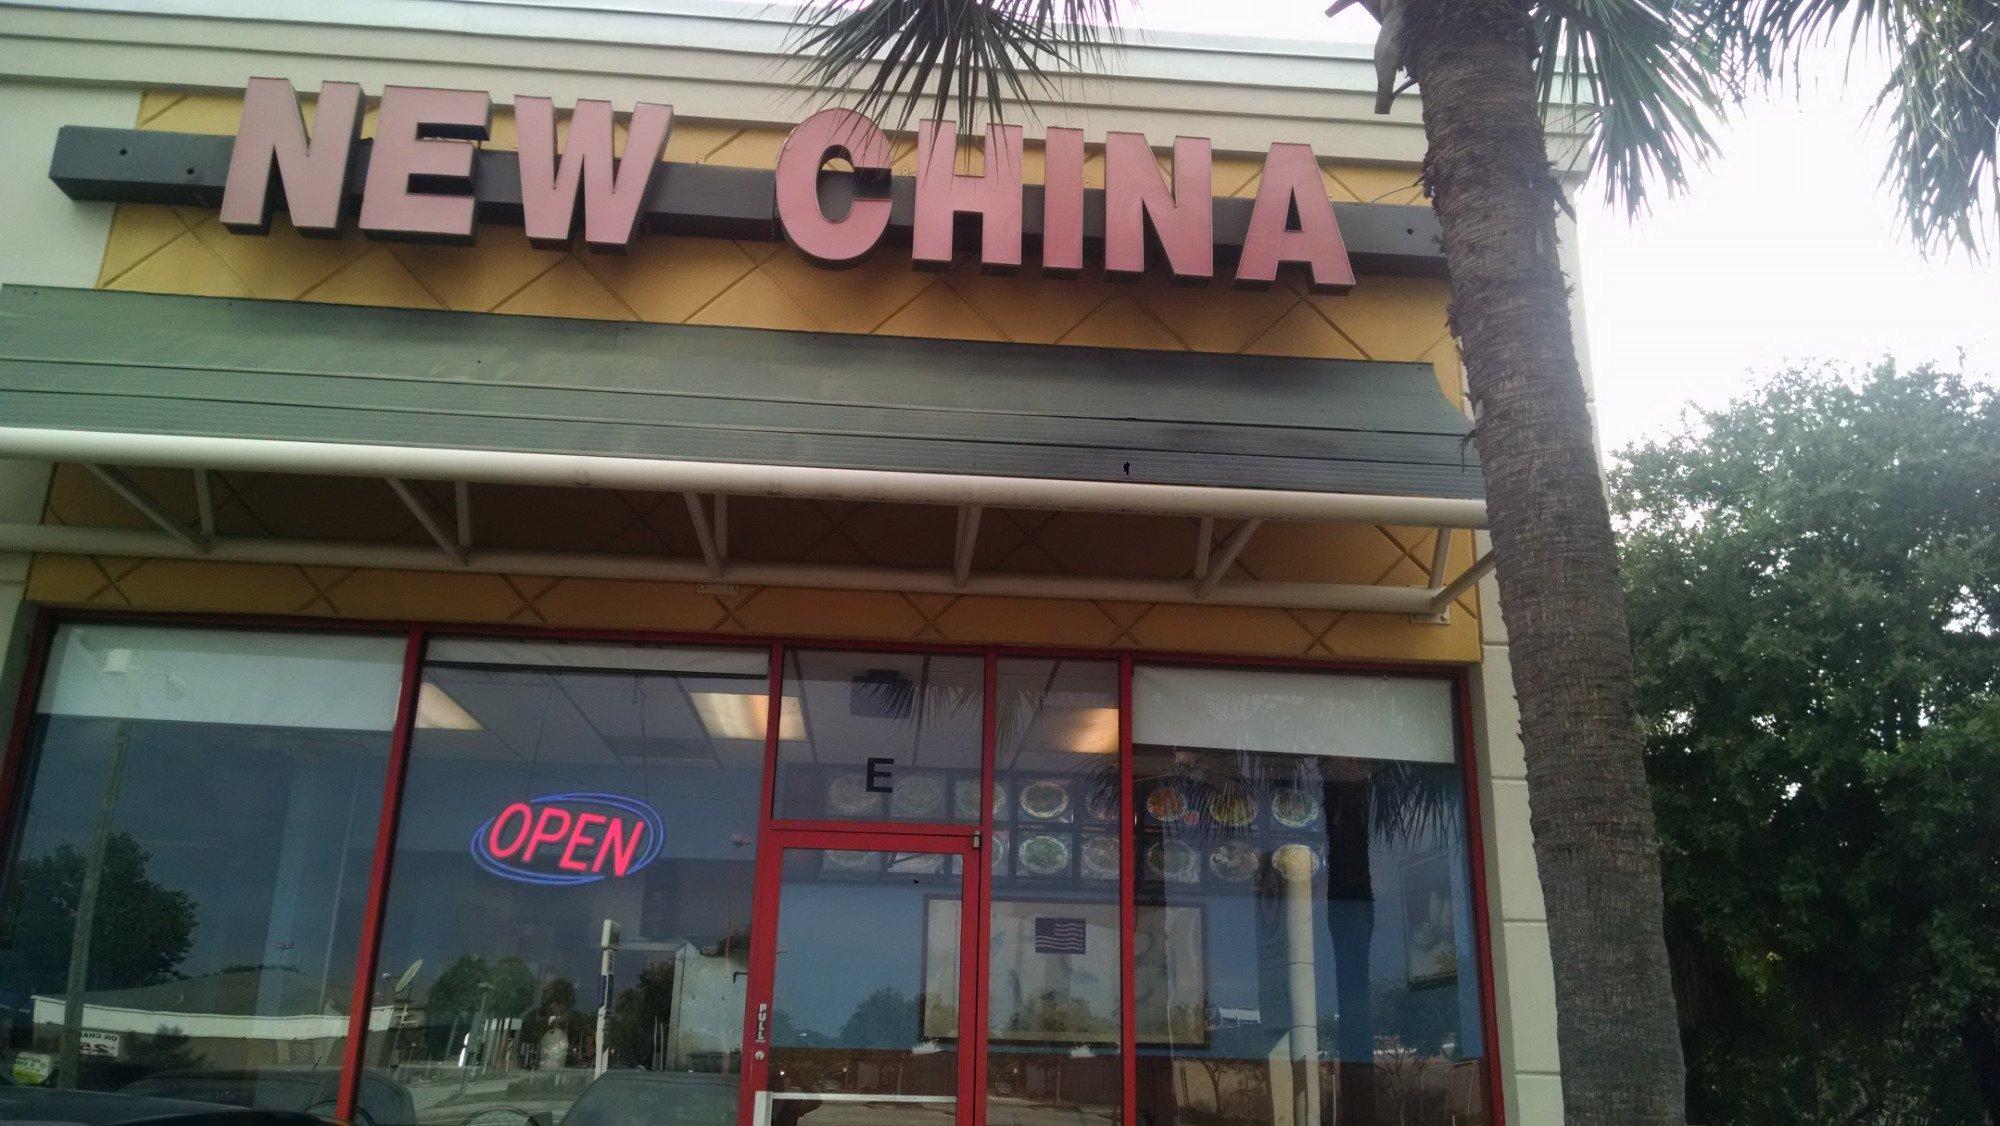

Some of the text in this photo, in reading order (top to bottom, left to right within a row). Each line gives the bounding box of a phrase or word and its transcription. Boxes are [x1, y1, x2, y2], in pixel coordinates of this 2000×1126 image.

[219, 77, 1356, 291] NEW CHINA
[867, 758, 894, 793] E
[488, 802, 646, 877] OPEN
[757, 1003, 767, 1040] PULL
